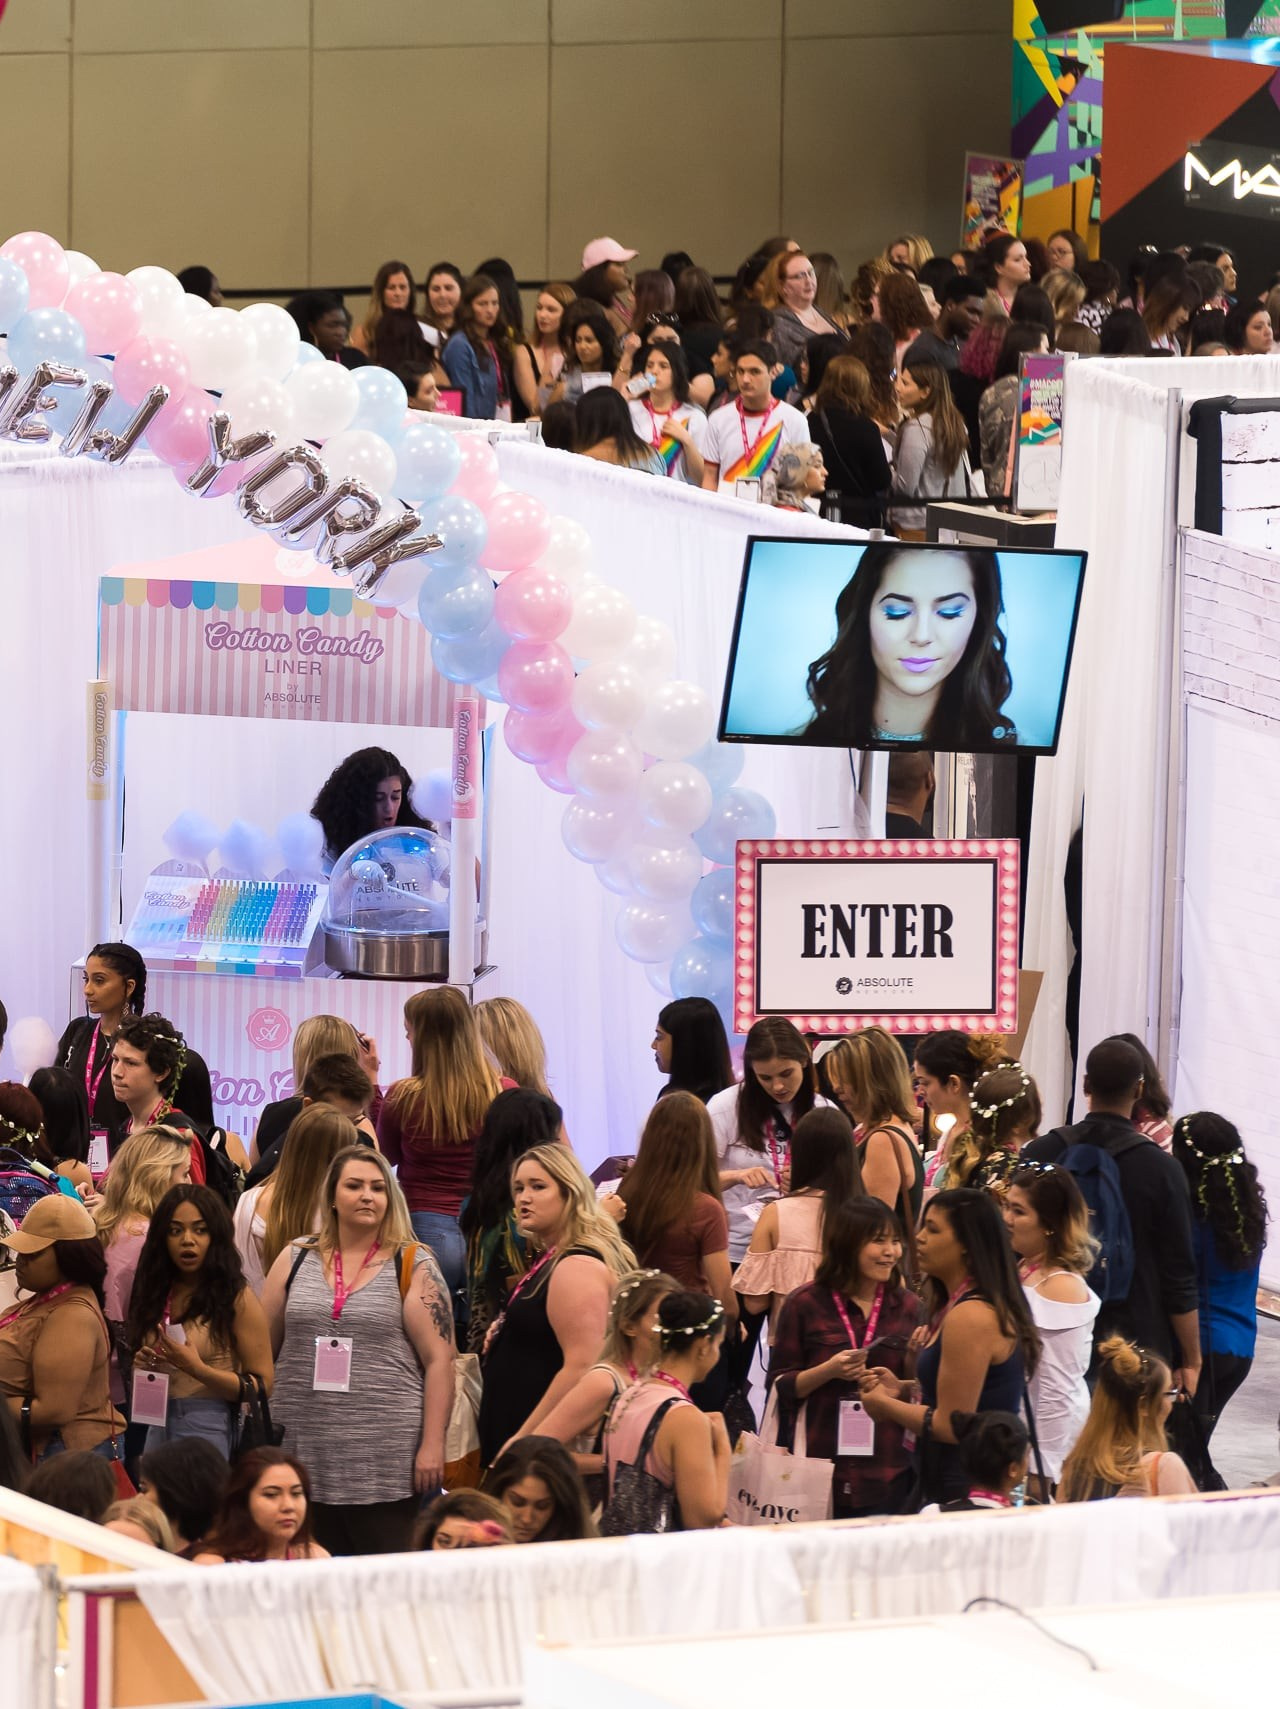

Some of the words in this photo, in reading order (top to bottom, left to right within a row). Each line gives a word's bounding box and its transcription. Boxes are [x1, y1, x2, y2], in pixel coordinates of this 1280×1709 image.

[185, 408, 447, 601] YORK
[205, 622, 292, 652] Cotton
[296, 627, 384, 664] Candy
[264, 660, 322, 676] LINER
[286, 683, 299, 692] by
[95, 692, 108, 734] Cotton
[264, 692, 321, 705] ABSOLUTE
[458, 710, 471, 750] Cotton
[91, 734, 109, 778] Candy
[455, 753, 470, 796] Candy
[357, 881, 421, 894] ABSUTE
[800, 903, 954, 958] ENTER
[857, 977, 914, 987] ABSOLUTE
